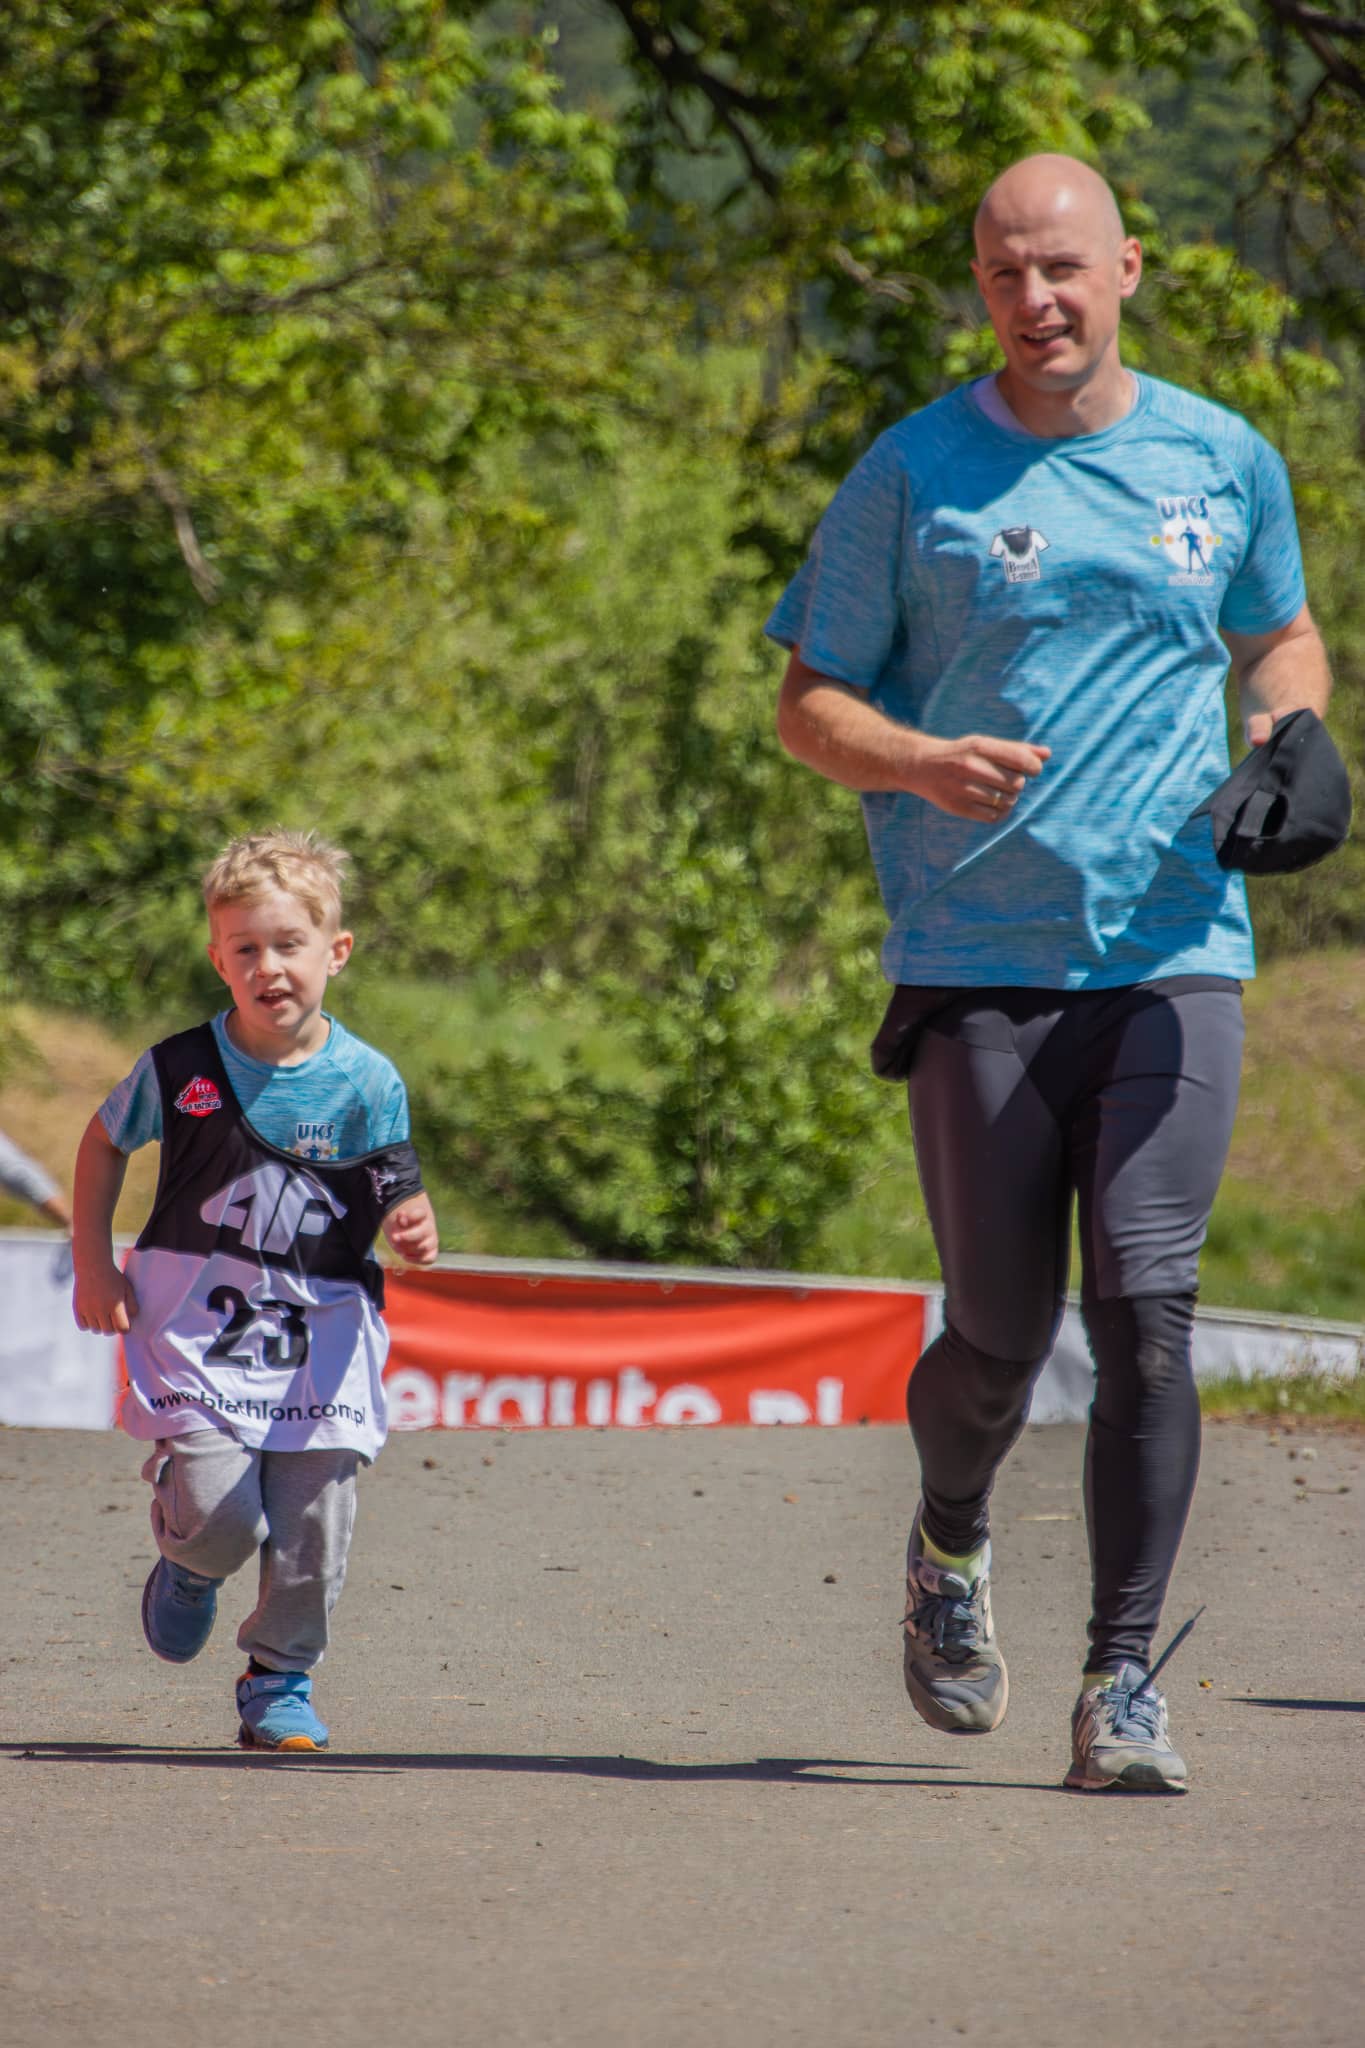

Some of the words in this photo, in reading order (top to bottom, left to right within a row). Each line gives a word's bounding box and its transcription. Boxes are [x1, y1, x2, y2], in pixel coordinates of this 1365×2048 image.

[1159, 495, 1209, 519] UKS
[297, 1123, 335, 1140] UKS
[203, 1284, 308, 1372] 23
[150, 1390, 366, 1426] www.biathlon.com.pl
